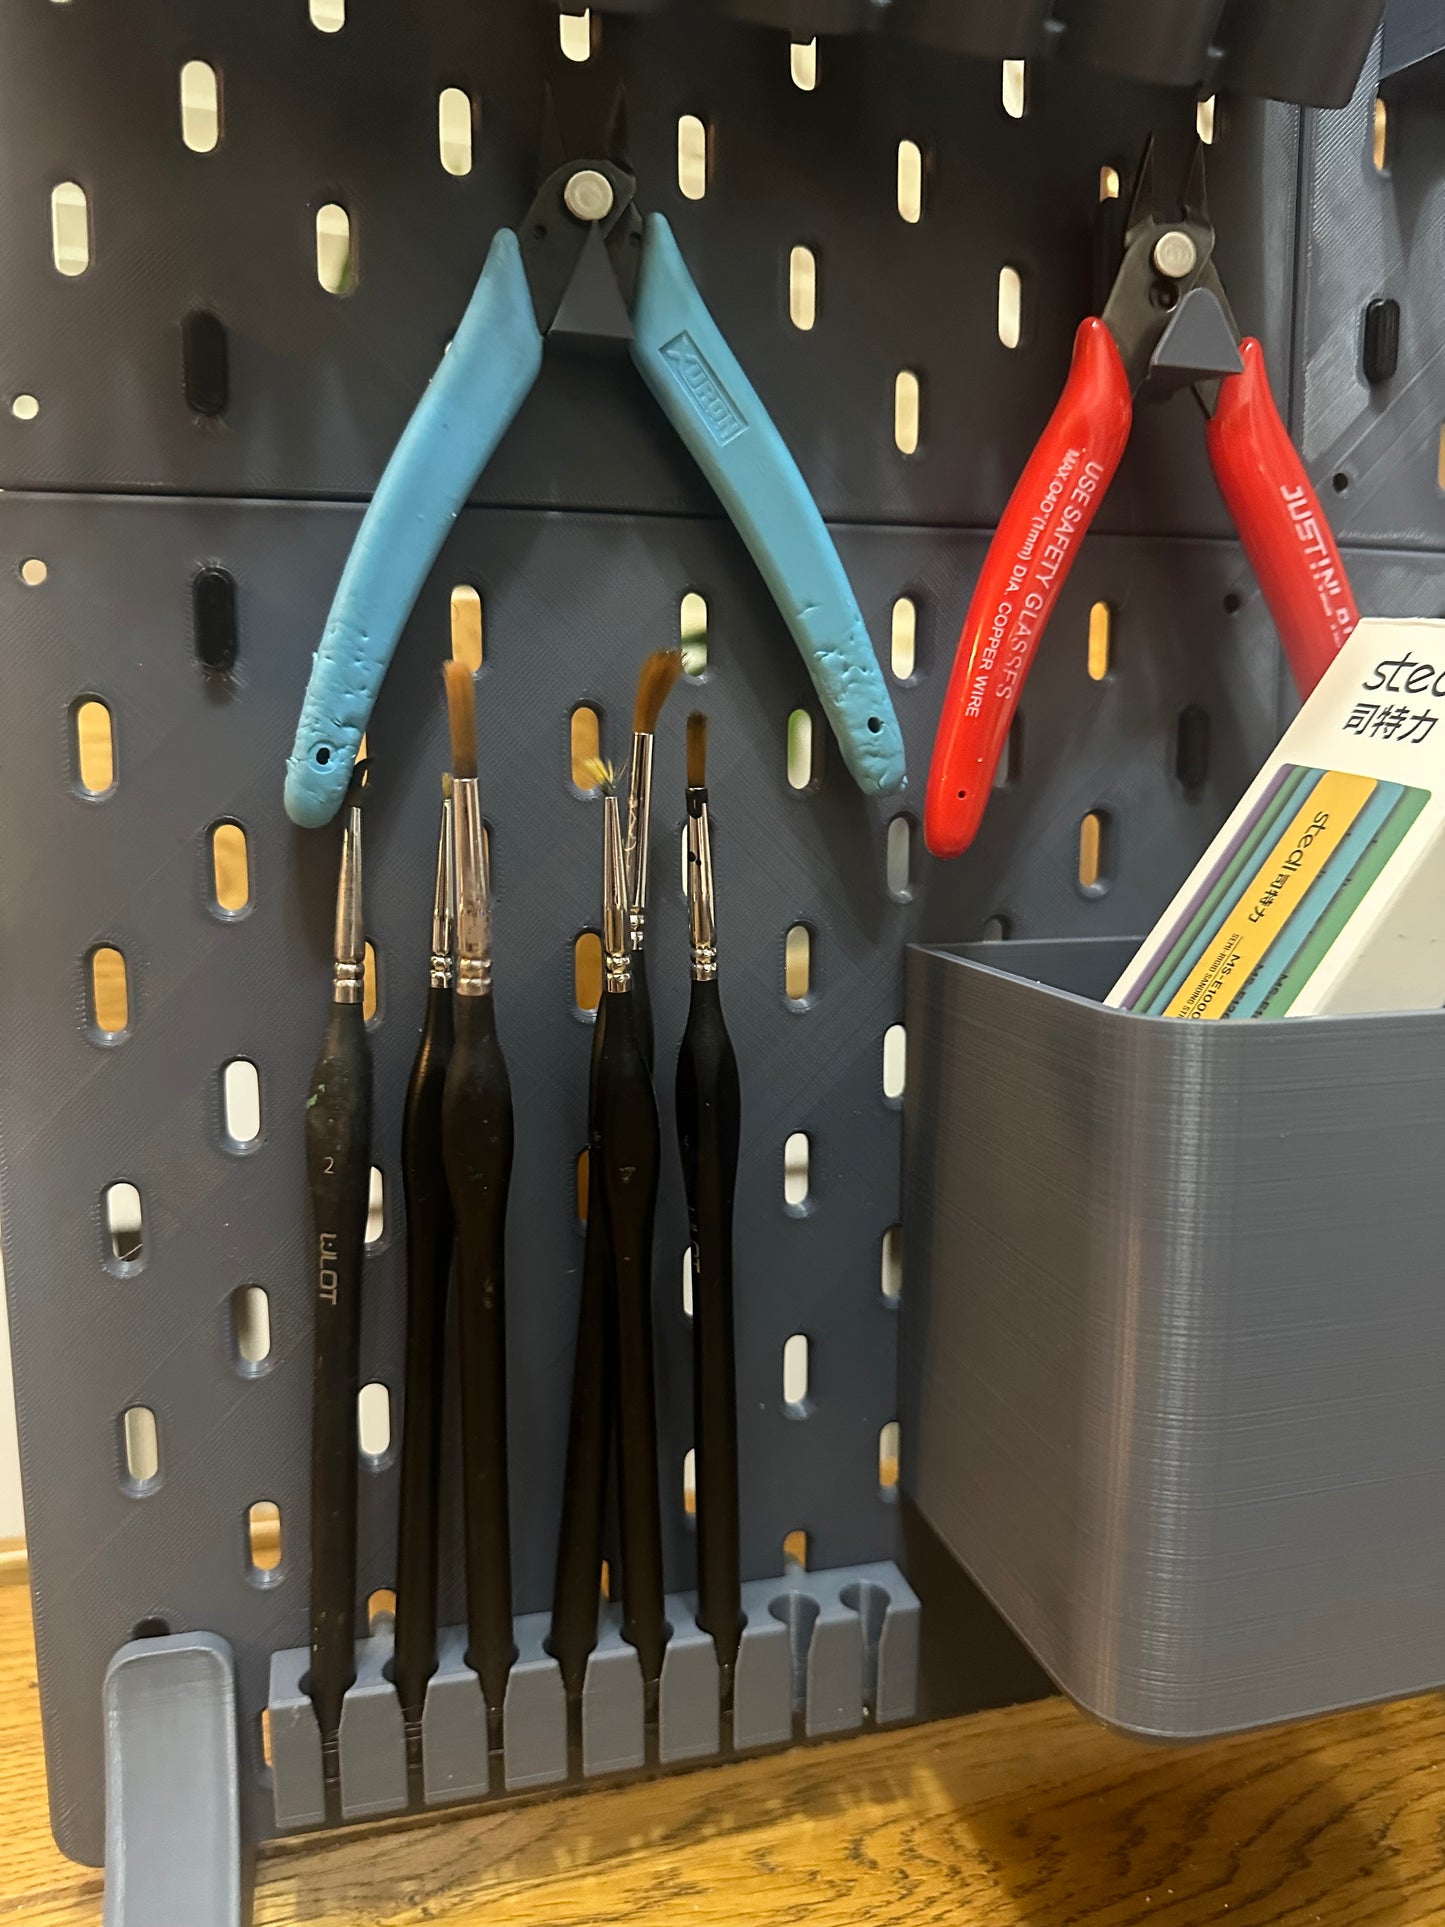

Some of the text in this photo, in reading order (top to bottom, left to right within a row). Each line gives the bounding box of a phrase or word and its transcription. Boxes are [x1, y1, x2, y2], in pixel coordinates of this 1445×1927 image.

[666, 334, 741, 438] XURON
[1072, 461, 1103, 506] USE
[1041, 505, 1081, 589] SAFETY
[1005, 564, 1028, 597] DIA.
[982, 602, 1012, 670] COPPER
[965, 675, 989, 718] WIRE
[1342, 703, 1439, 743] 司特力
[1248, 873, 1292, 923] 司特力
[1209, 933, 1238, 972] SEMI-RIGID
[1187, 973, 1212, 1005] SANDING
[323, 1156, 334, 1174] 2
